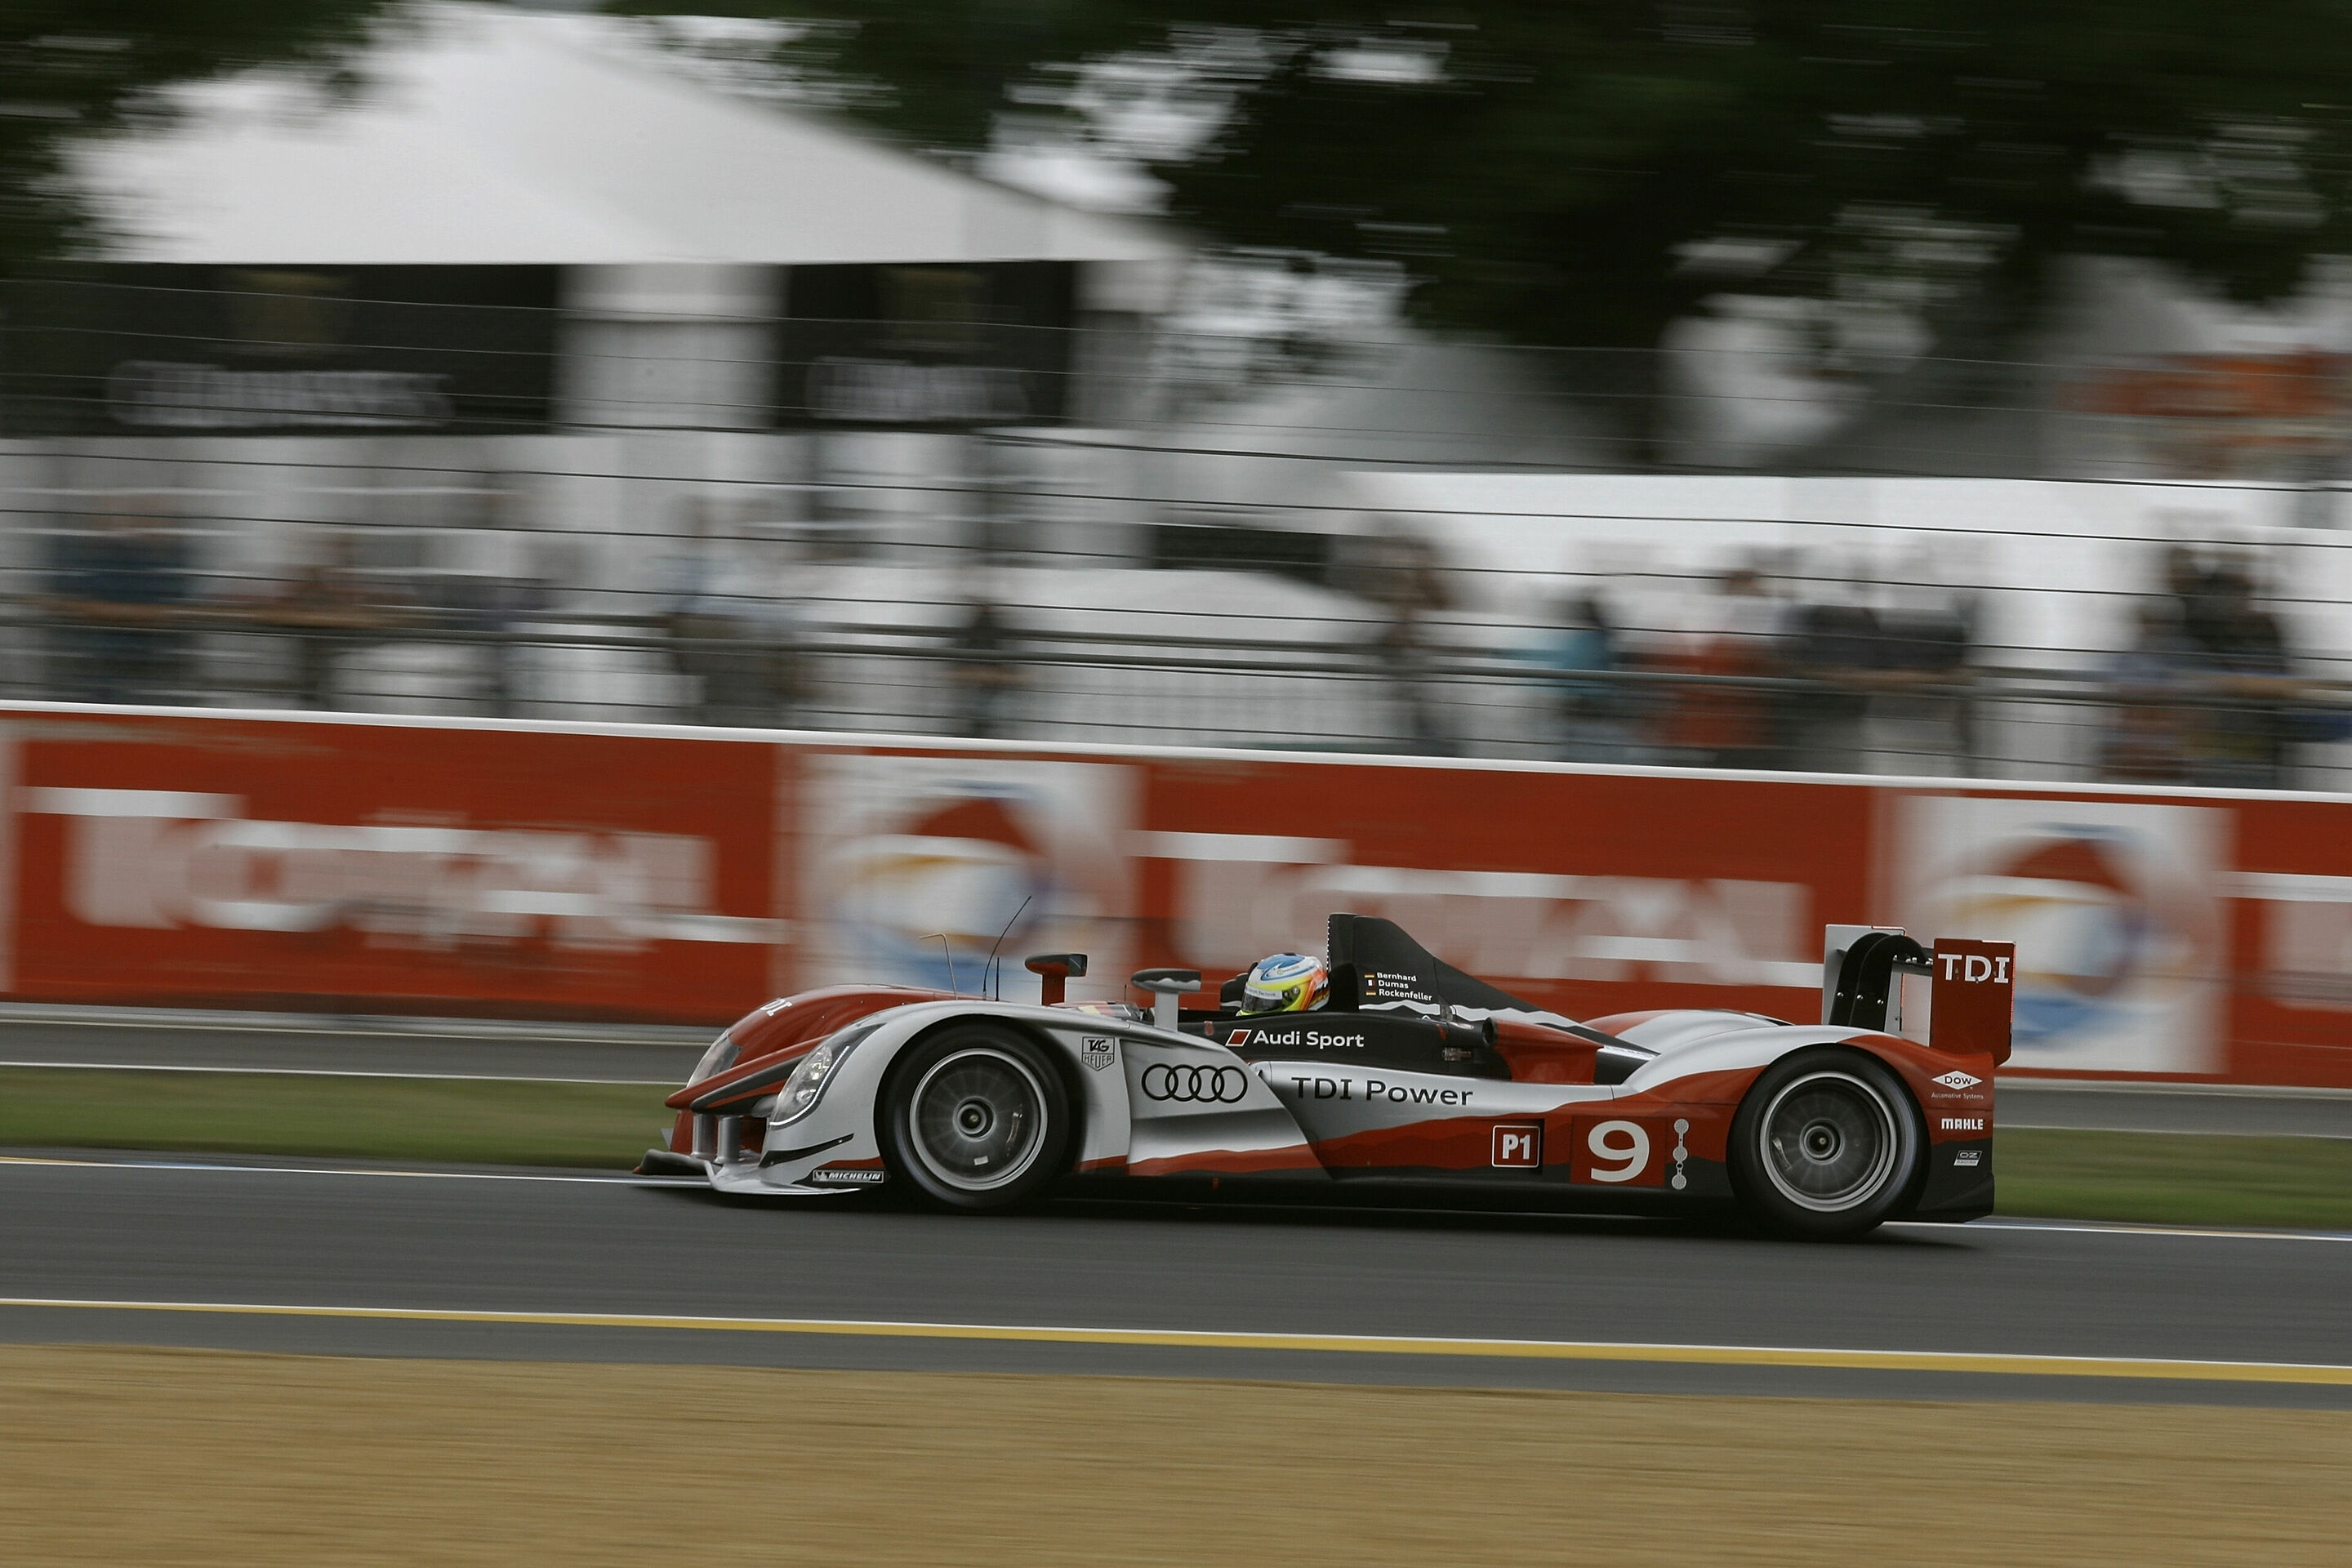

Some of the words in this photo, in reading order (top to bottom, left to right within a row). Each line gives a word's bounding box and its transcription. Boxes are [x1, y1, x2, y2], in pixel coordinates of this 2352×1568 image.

[1938, 953, 2011, 983] TDI
[1377, 972, 1417, 982] Bernhard
[1378, 979, 1409, 989] Dumas
[1379, 988, 1432, 1001] Rockenfeller
[1088, 1039, 1110, 1052] TAG
[1253, 1030, 1300, 1045] Audi
[1306, 1031, 1365, 1049] Sport
[1084, 1054, 1112, 1069] HEUER
[1291, 1076, 1352, 1100] TDI
[1365, 1080, 1473, 1106] Power
[1941, 1118, 1984, 1130] MAHLE
[1502, 1134, 1530, 1160] P1
[1588, 1120, 1650, 1183] 9
[828, 1171, 880, 1181] MICHELIN
